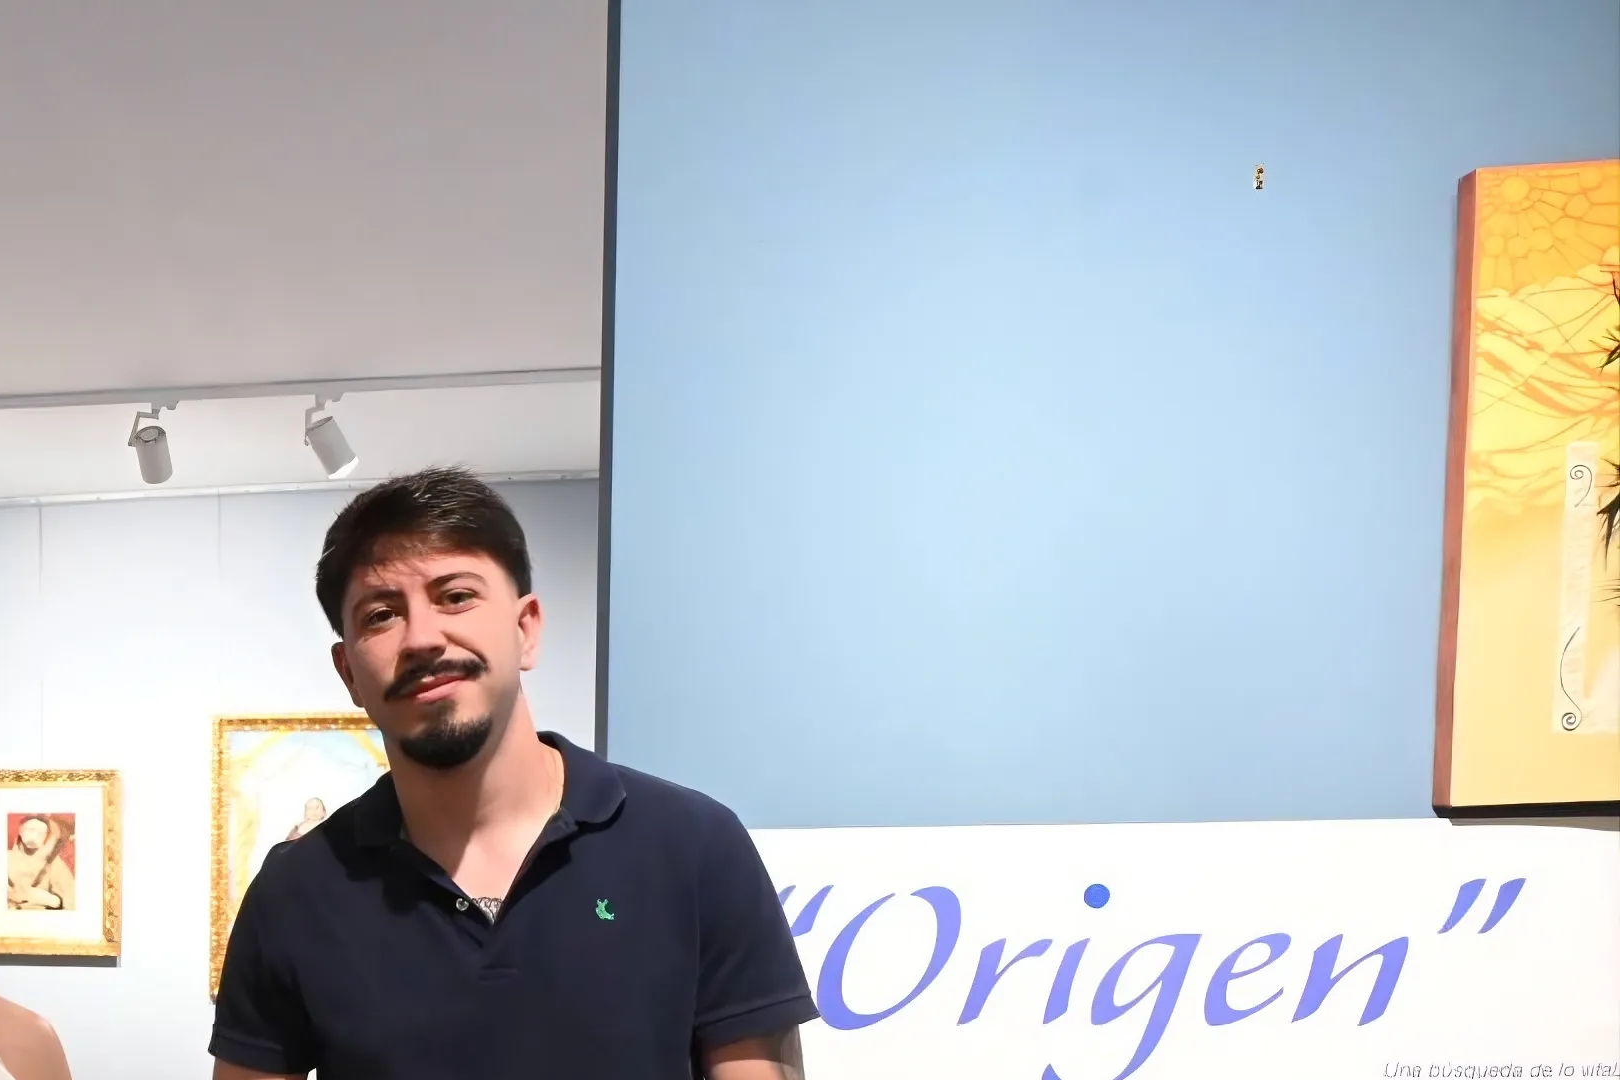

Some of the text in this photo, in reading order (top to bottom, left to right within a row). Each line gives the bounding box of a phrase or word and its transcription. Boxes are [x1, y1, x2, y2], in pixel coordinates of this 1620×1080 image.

[1383, 1062, 1422, 1078] Una
[1428, 1061, 1522, 1079] búsqueda
[1530, 1062, 1553, 1078] de
[1558, 1062, 1576, 1078] lo
